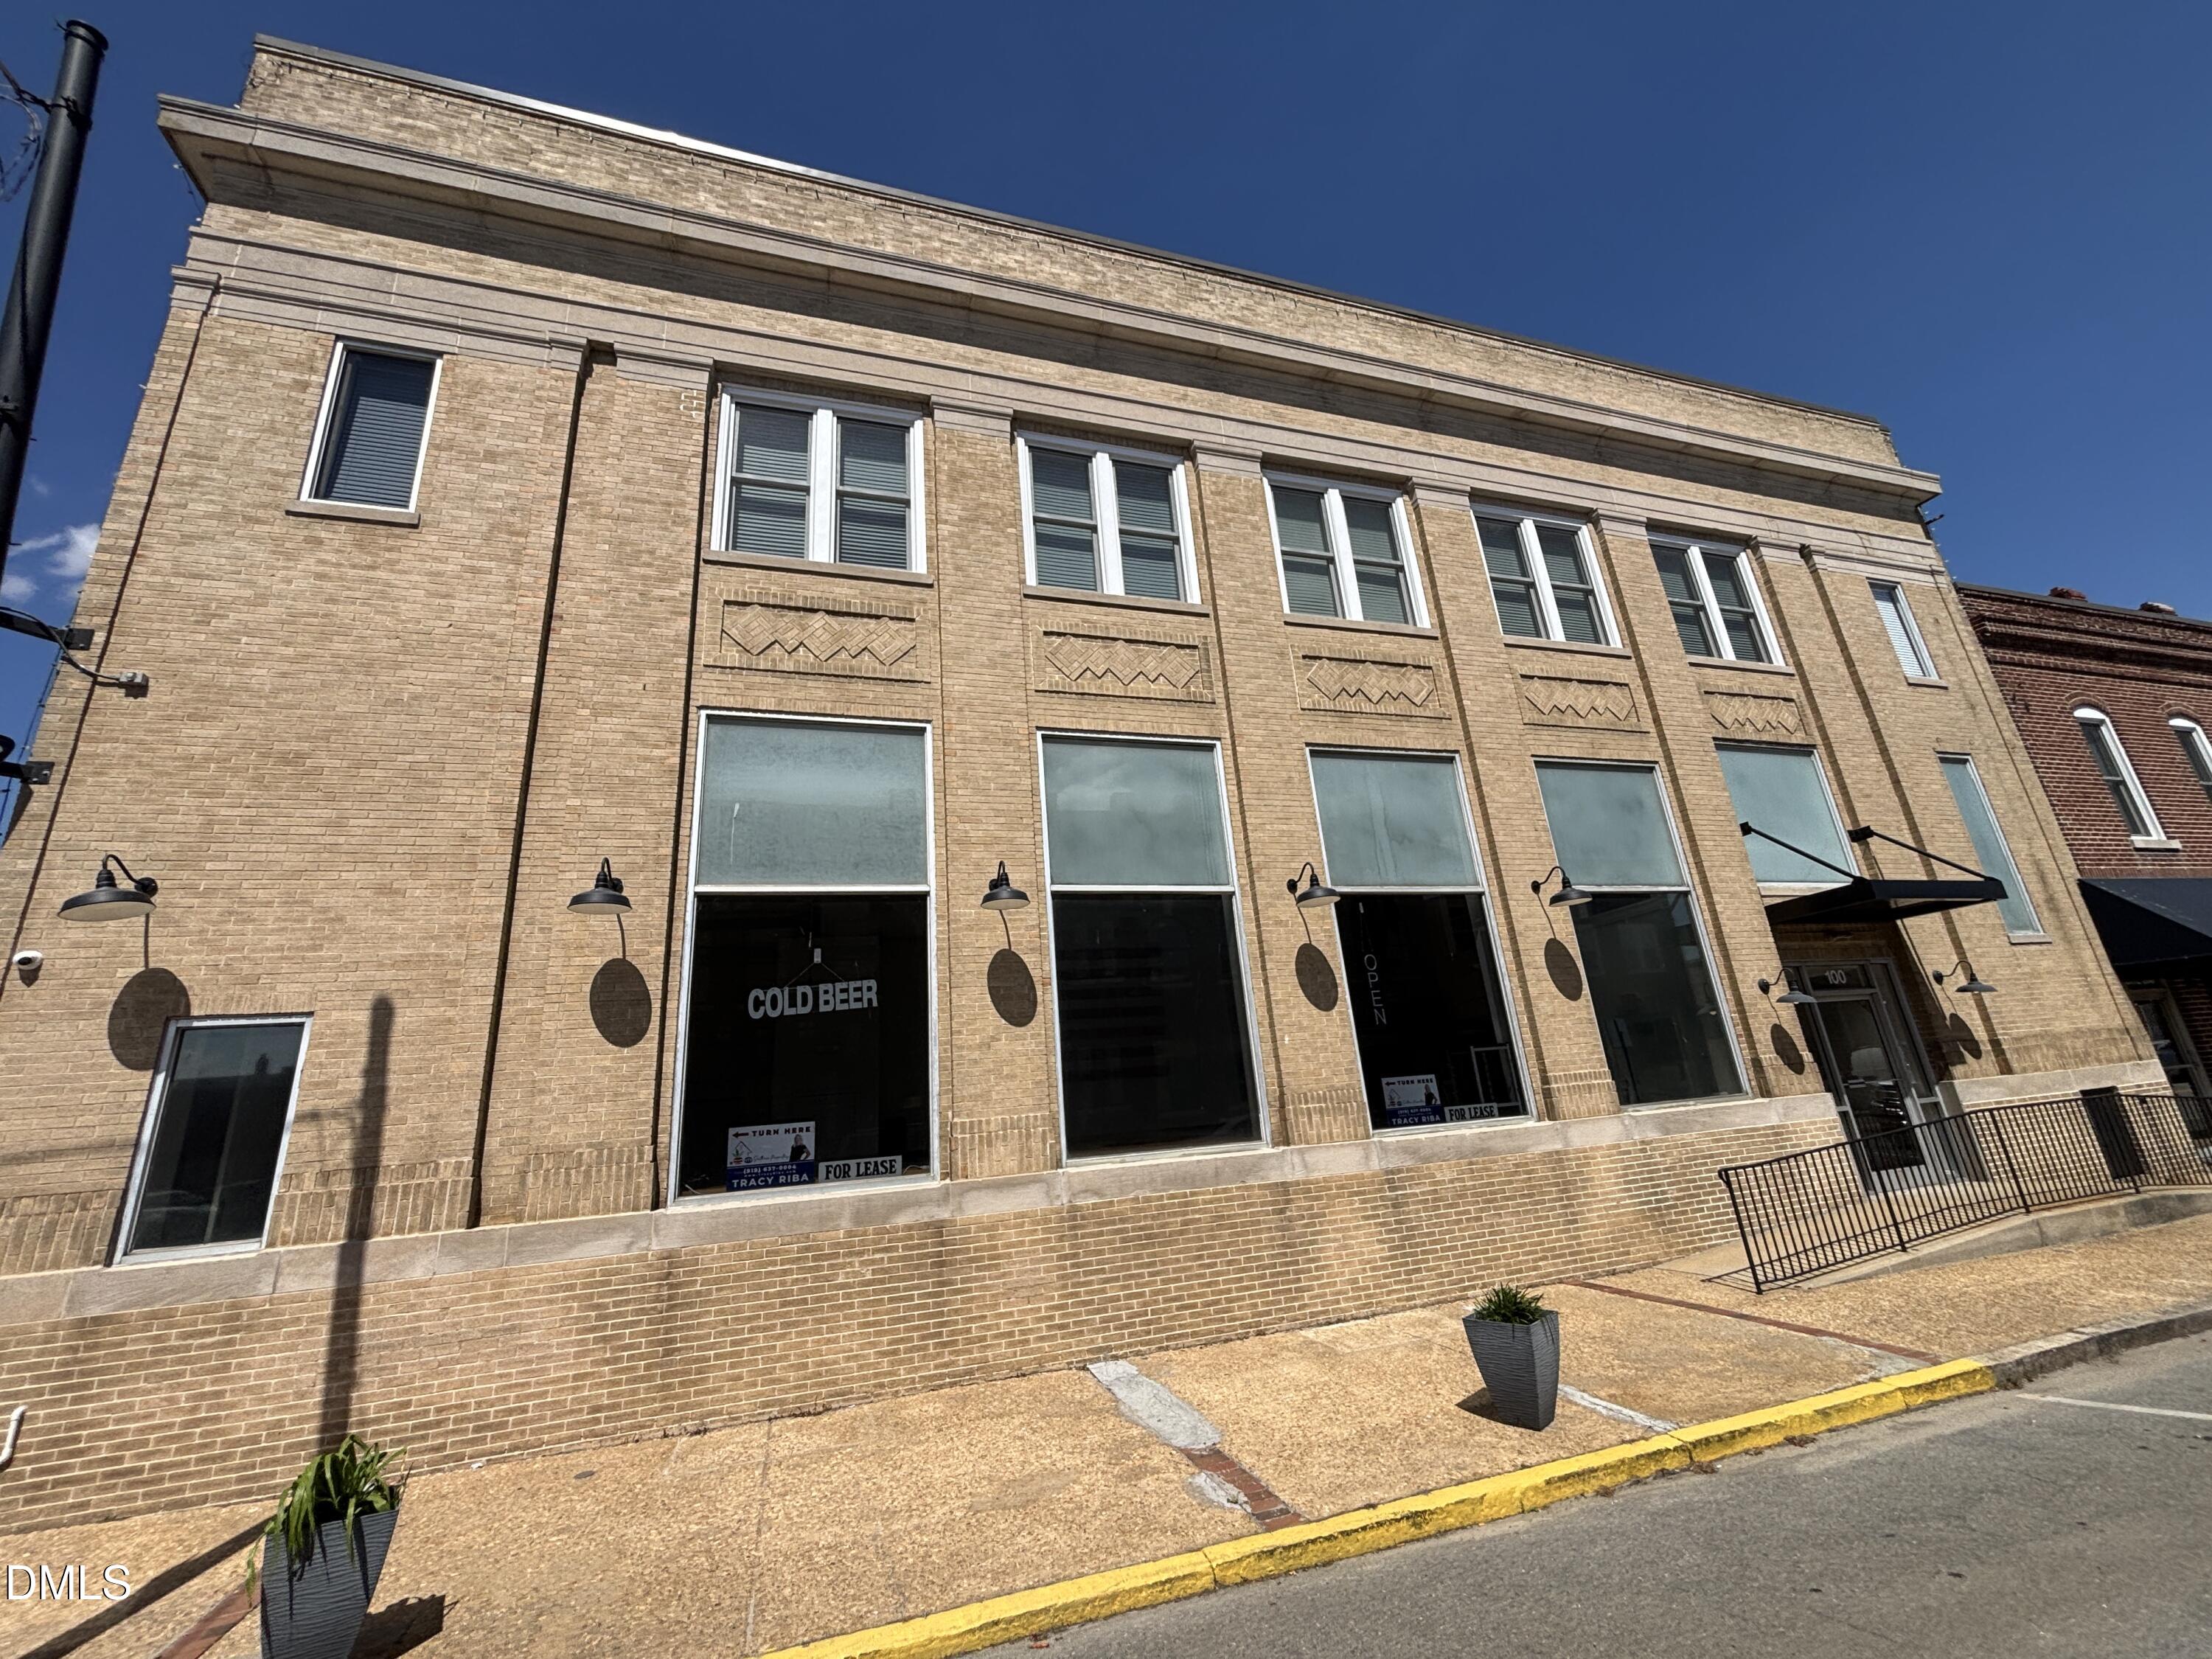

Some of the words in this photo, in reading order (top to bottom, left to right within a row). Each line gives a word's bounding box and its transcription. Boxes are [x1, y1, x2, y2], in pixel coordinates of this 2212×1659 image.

[1825, 970, 1847, 984] 100
[1364, 954, 1387, 1025] OPEN
[748, 985, 813, 1019] COLD
[818, 979, 878, 1012] BEER
[1392, 1116, 1419, 1125] TRACY
[1449, 1108, 1467, 1121] FOR
[1468, 1105, 1495, 1119] LEASE
[824, 1163, 851, 1180] FOR
[855, 1159, 897, 1178] LEASE
[731, 1176, 774, 1188] TRACY
[779, 1174, 809, 1183] RIBA
